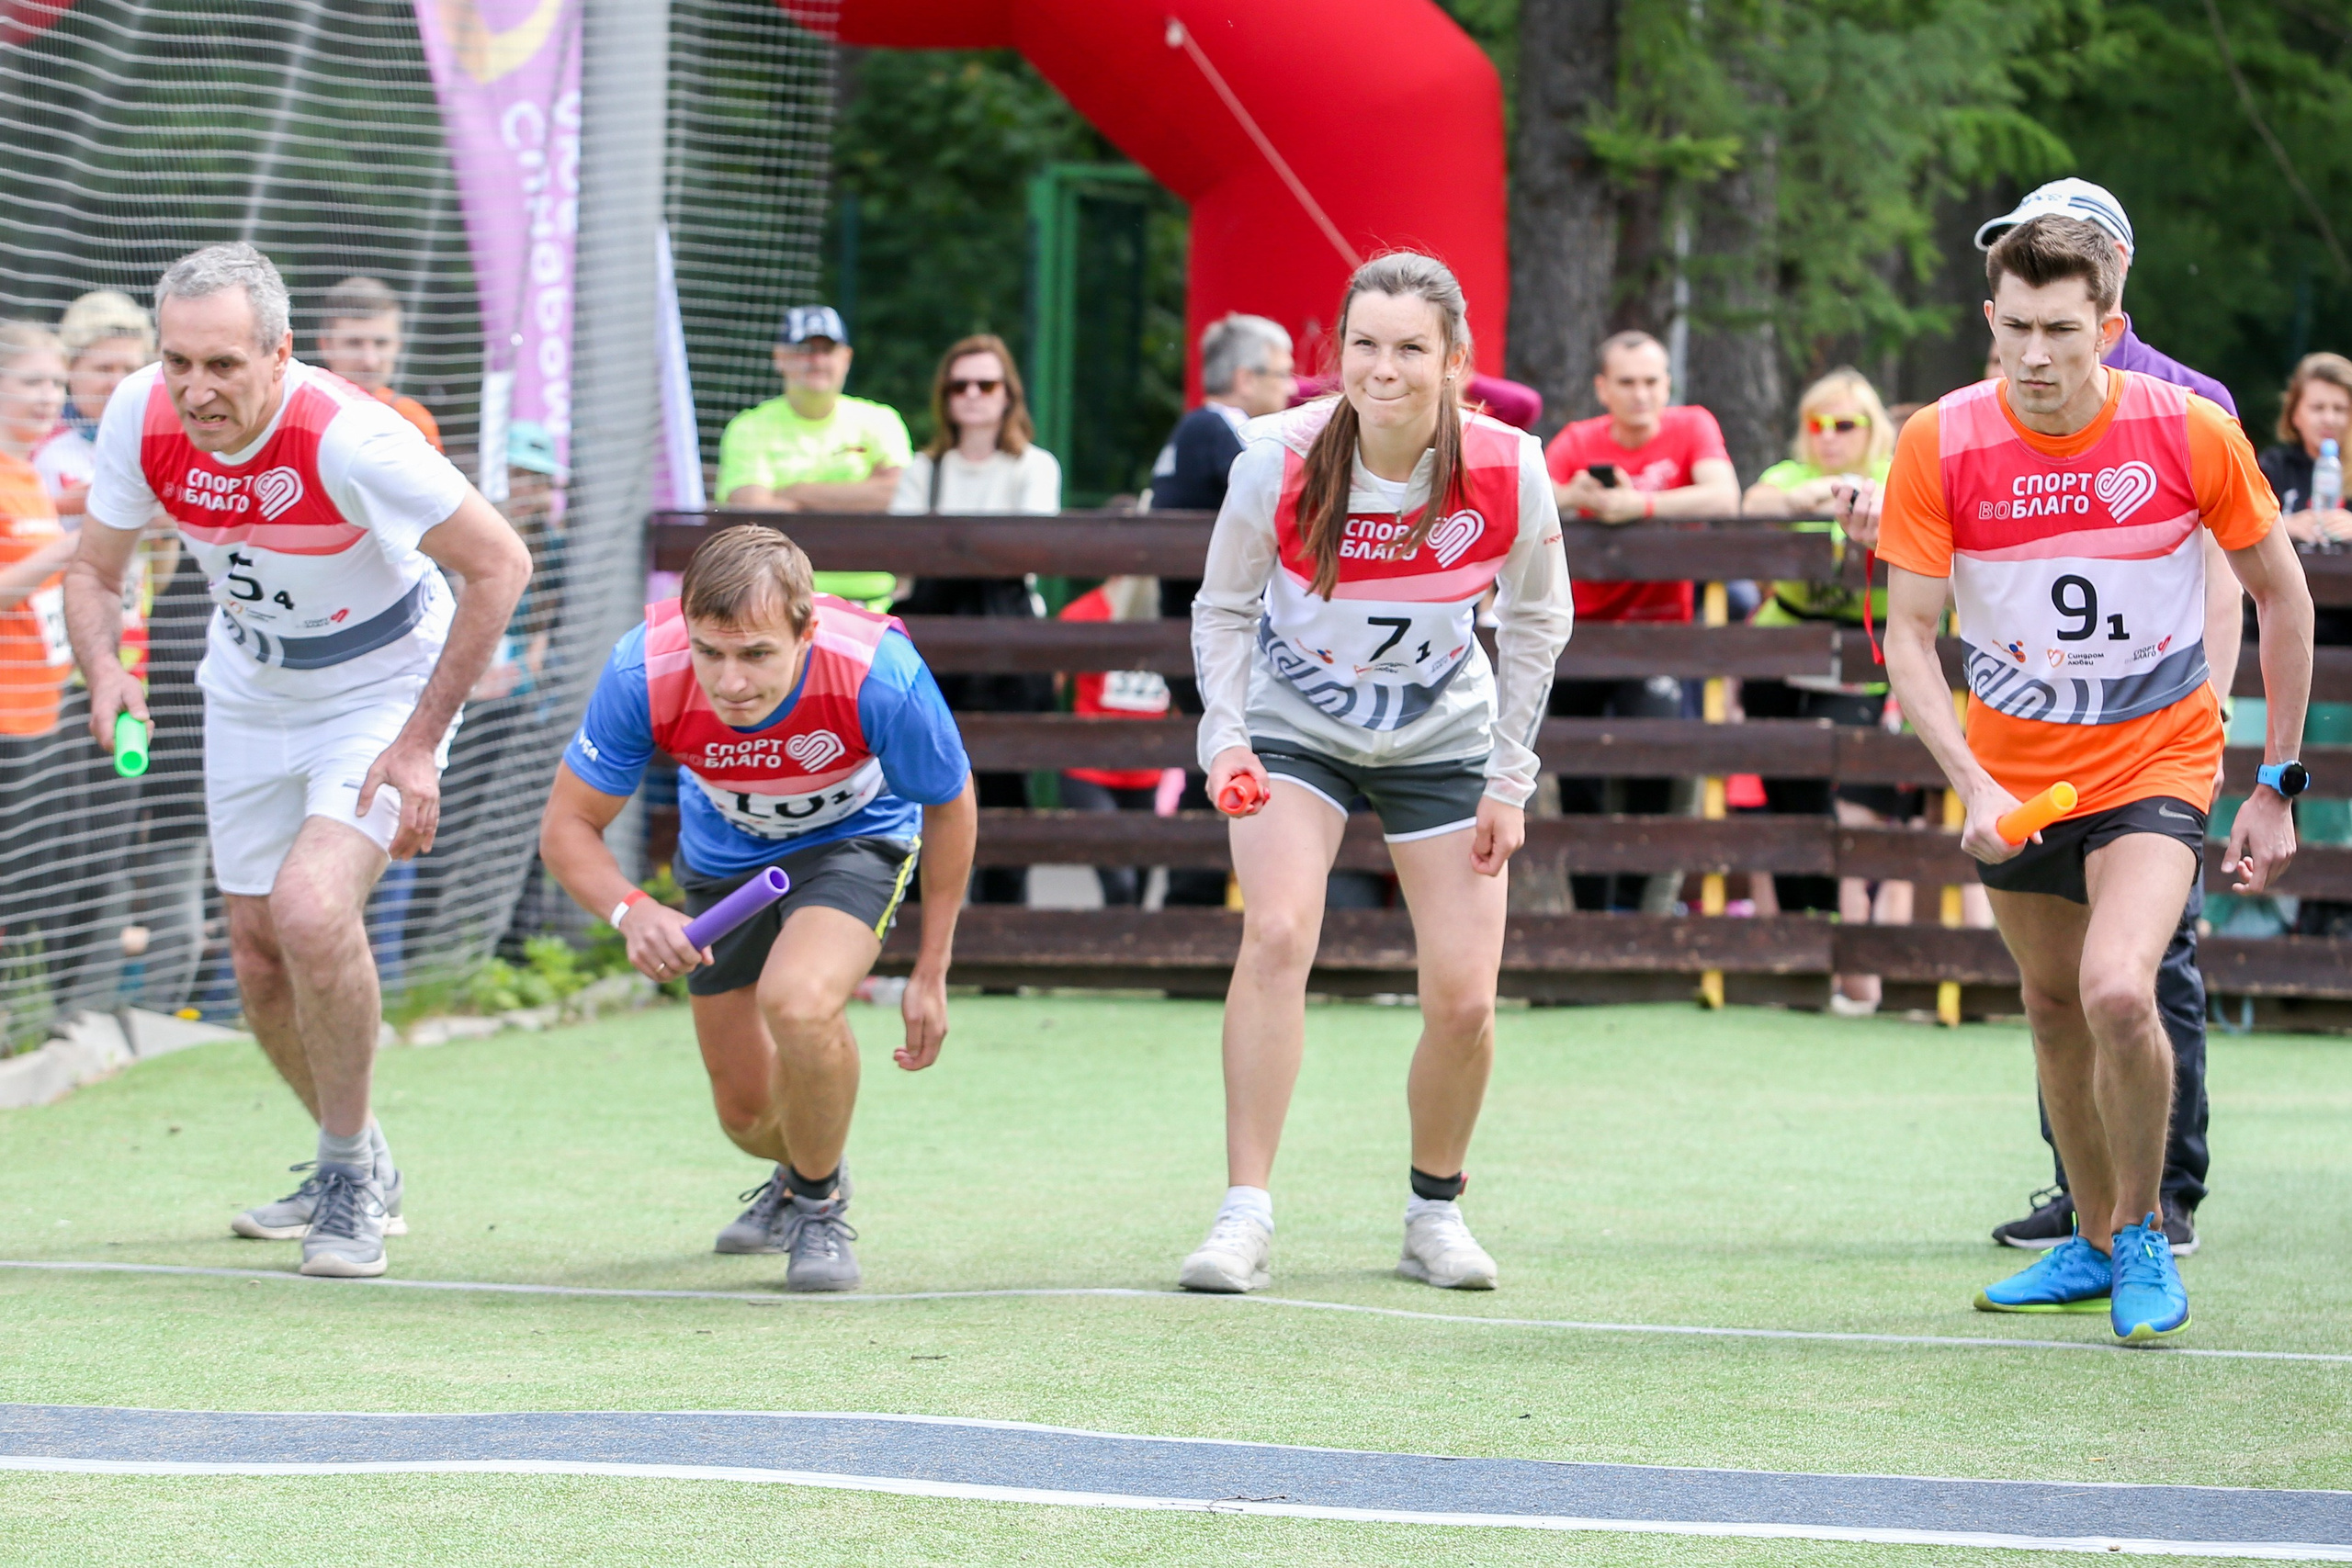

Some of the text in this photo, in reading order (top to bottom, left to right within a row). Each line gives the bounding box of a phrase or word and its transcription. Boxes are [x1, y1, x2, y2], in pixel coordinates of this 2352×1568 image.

[186, 467, 254, 494] СПОРТ
[2011, 472, 2093, 497] СПОРТ
[1344, 518, 1419, 542] СПОР
[2051, 573, 2098, 641] 9
[1367, 616, 1412, 663] 7
[705, 739, 784, 757] СПОРТ
